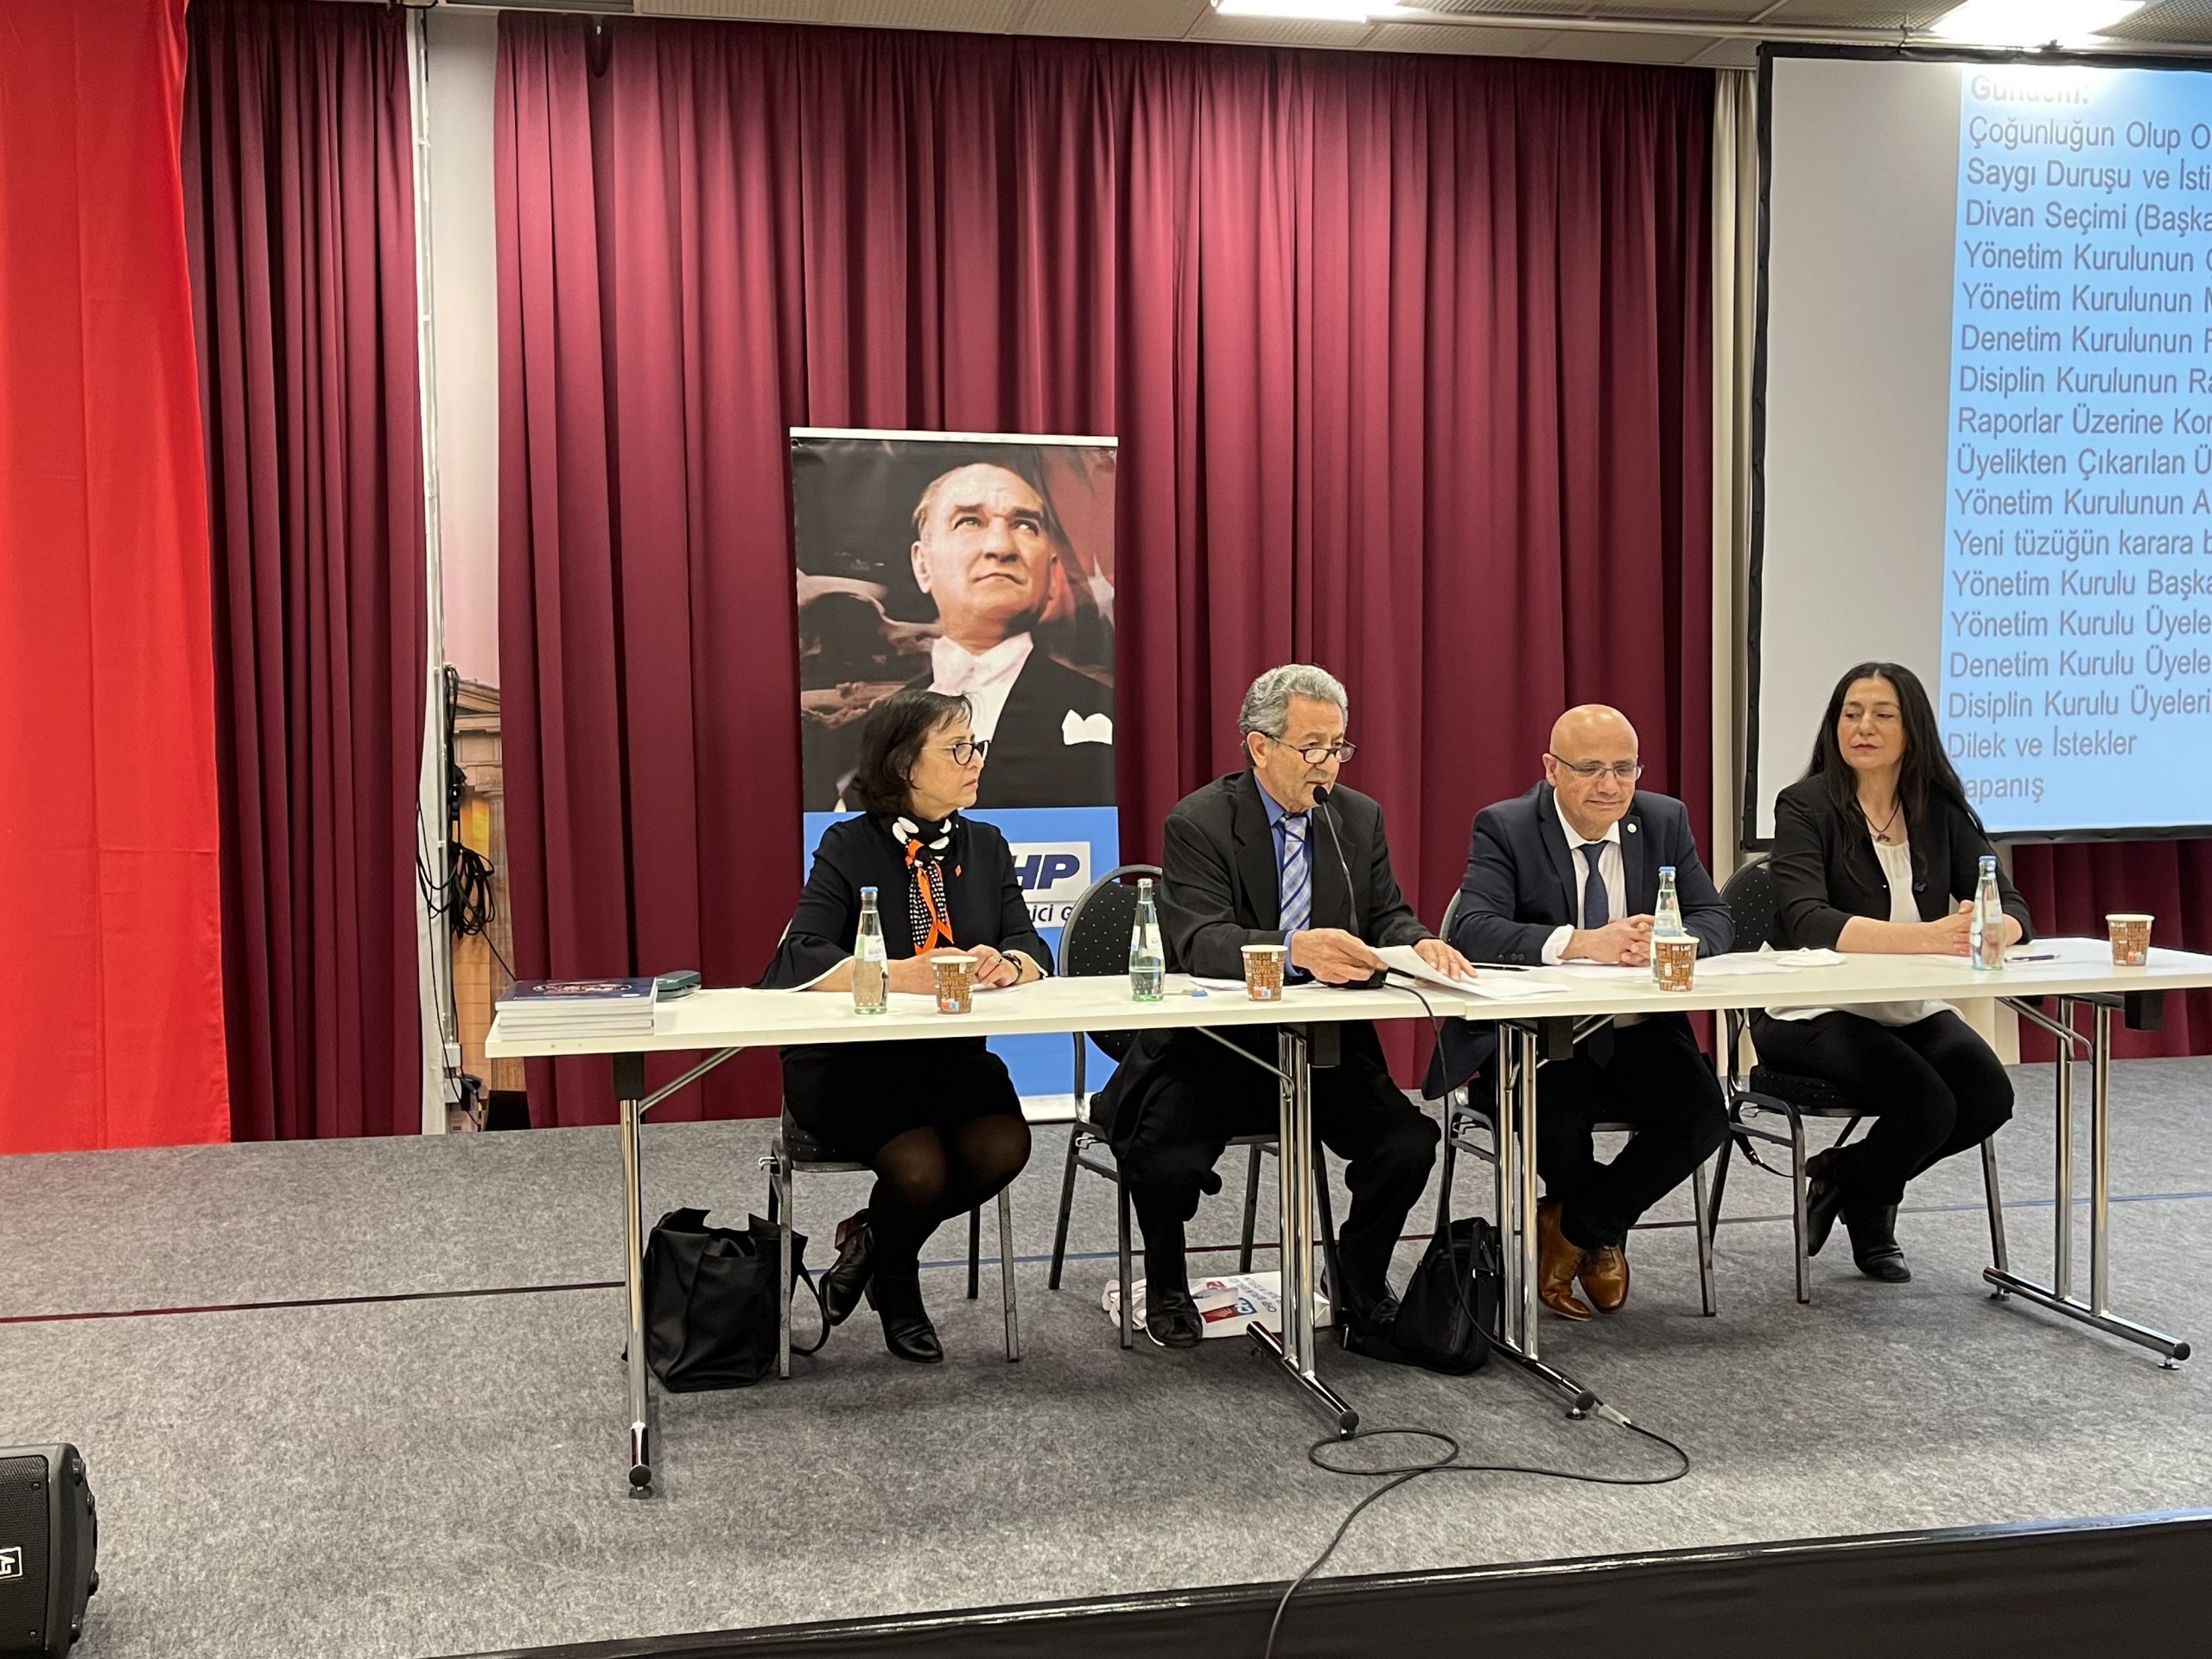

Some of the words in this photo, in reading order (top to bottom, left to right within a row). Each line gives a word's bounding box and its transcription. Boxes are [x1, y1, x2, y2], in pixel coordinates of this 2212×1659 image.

[1969, 116, 2113, 152] Çoğunluğun
[2126, 121, 2181, 156] Olup
[1967, 157, 2036, 193] Saygı
[2047, 160, 2130, 194] Duruşu
[2143, 169, 2170, 189] ve
[1967, 200, 2033, 227] Divan
[2044, 201, 2126, 235] Seçimi
[1964, 240, 2062, 270] Yönetim
[2075, 243, 2193, 272] Kurulunun
[1962, 283, 2060, 310] Yönetim
[2073, 284, 2191, 313] Kurulunun
[1961, 325, 2061, 352] Denetim
[2073, 326, 2192, 353] Kurulunun
[1960, 365, 2044, 399] Disiplin
[2057, 366, 2177, 393] Kurulunun
[1959, 406, 2063, 440] Raporlar
[2073, 403, 2163, 434] Üzerine
[1958, 442, 2066, 480] Üyelikten
[2078, 448, 2184, 481] Çıkarılan
[1955, 488, 2052, 515] Yönetim
[2064, 488, 2183, 515] Kurulunun
[2192, 488, 2210, 515] A
[1954, 529, 2004, 556] Yeni
[2015, 529, 2108, 563] tüzüğün
[2120, 529, 2192, 555] karara
[1951, 569, 2049, 596] Yönetim
[2062, 569, 2135, 595] Kurulu
[1951, 610, 2047, 637] Yönetim
[2060, 609, 2133, 636] Kurulu
[2146, 604, 2211, 642] Üyele
[1950, 651, 2048, 677] Denetim
[2060, 649, 2133, 676] Kurulu
[2146, 645, 2211, 682] Üyele
[1948, 691, 2031, 724] Disiplin
[2045, 690, 2119, 716] Kurulu
[1948, 732, 2005, 759] Dilek
[2015, 738, 2043, 757] ve
[2053, 725, 2138, 756] İstekler
[1965, 777, 2044, 804] apanış
[1012, 854, 1080, 890] HP
